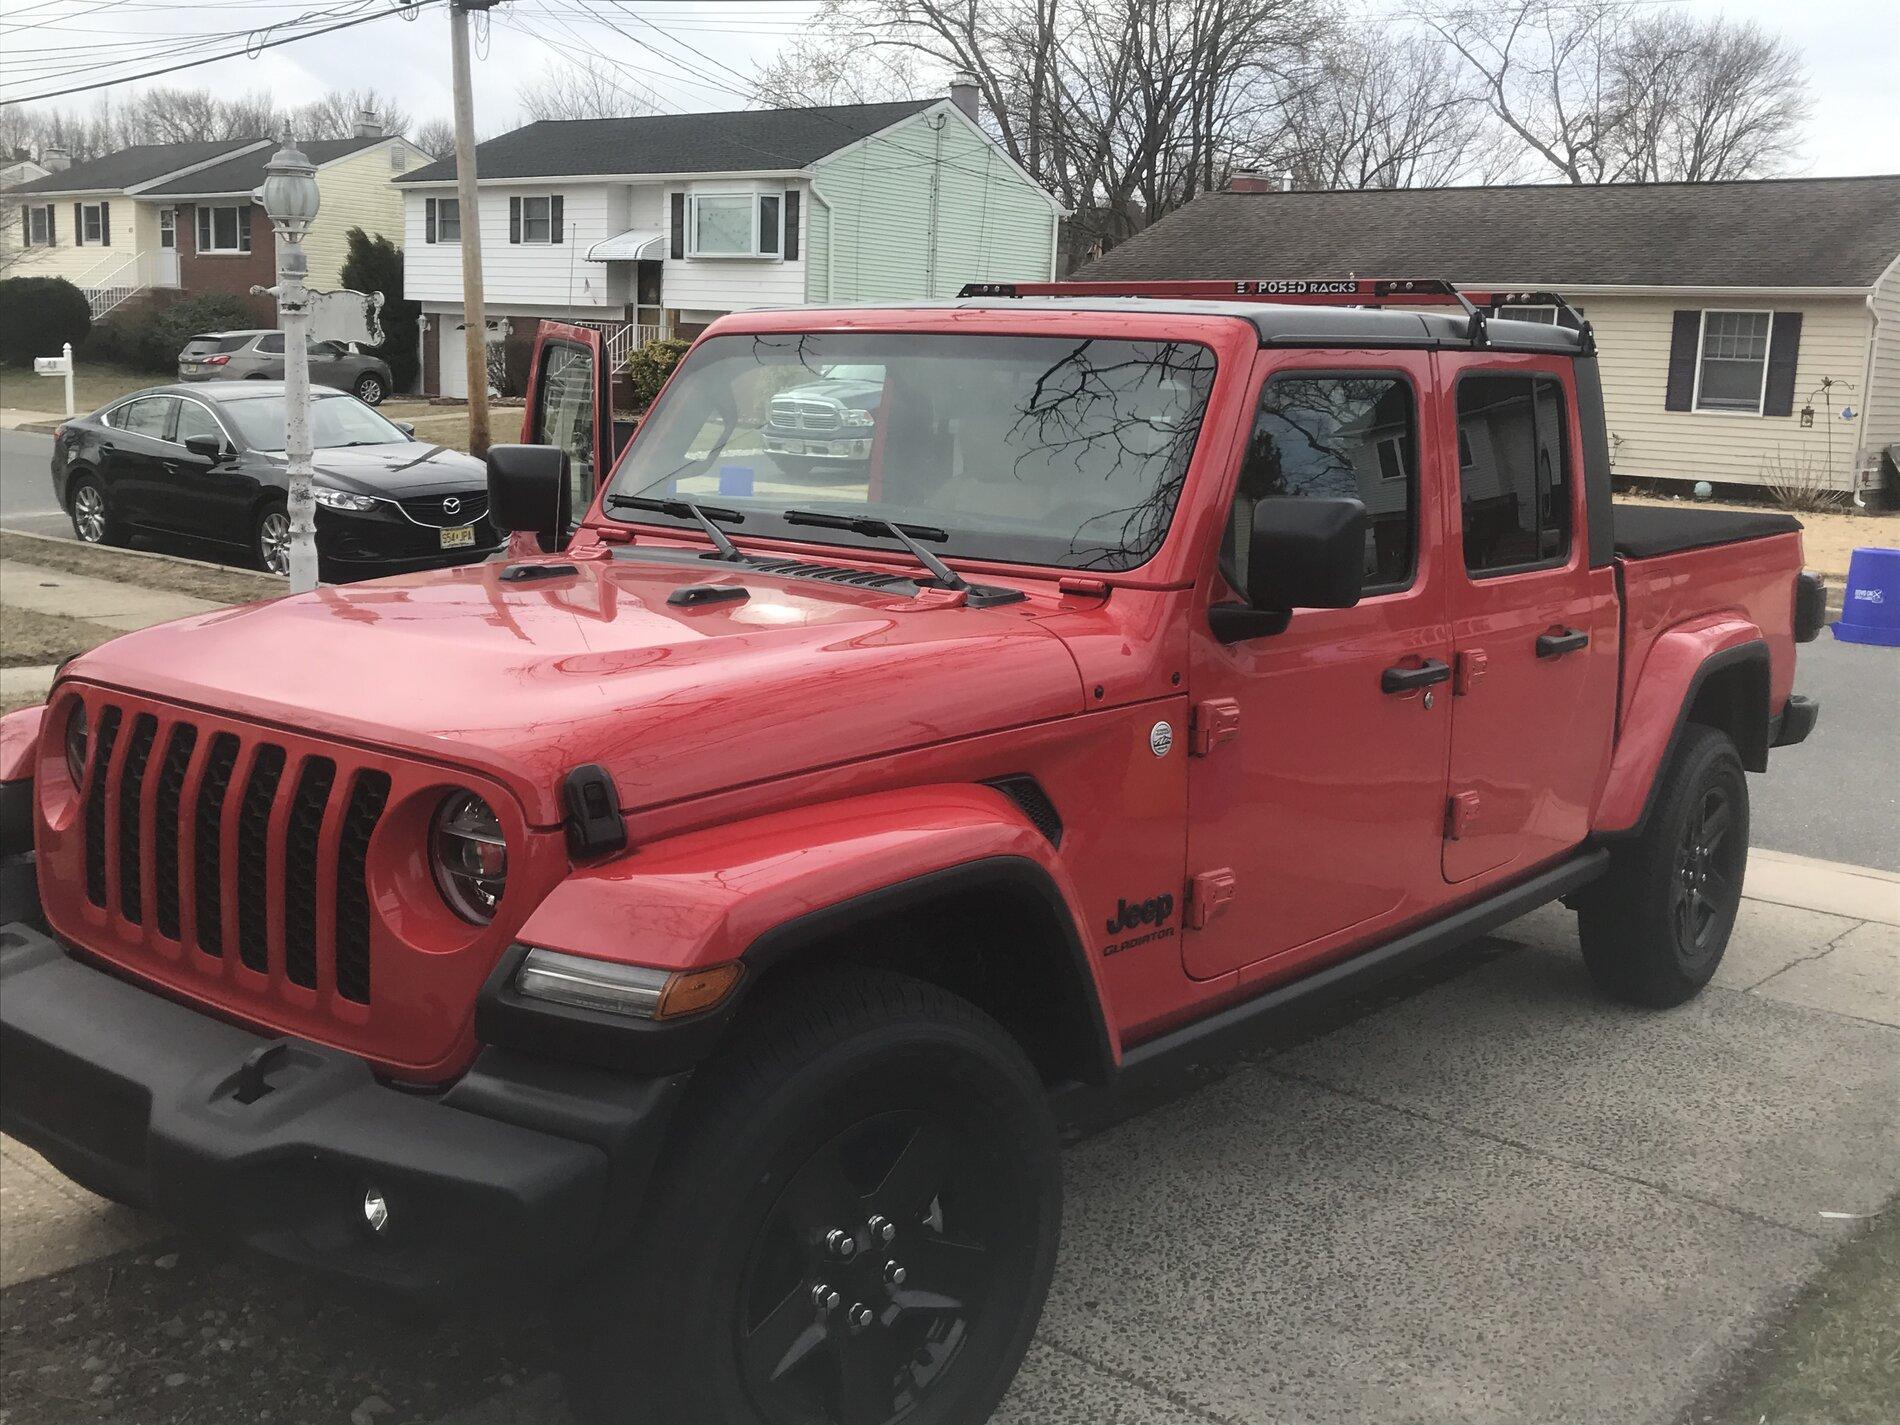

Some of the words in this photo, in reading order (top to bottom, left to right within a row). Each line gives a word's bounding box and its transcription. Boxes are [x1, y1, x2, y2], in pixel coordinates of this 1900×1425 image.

[1237, 281, 1307, 293] EXPOSED
[1310, 282, 1356, 293] RACKS
[1106, 894, 1173, 934] Jeep
[1103, 927, 1174, 957] GLADIATOR
